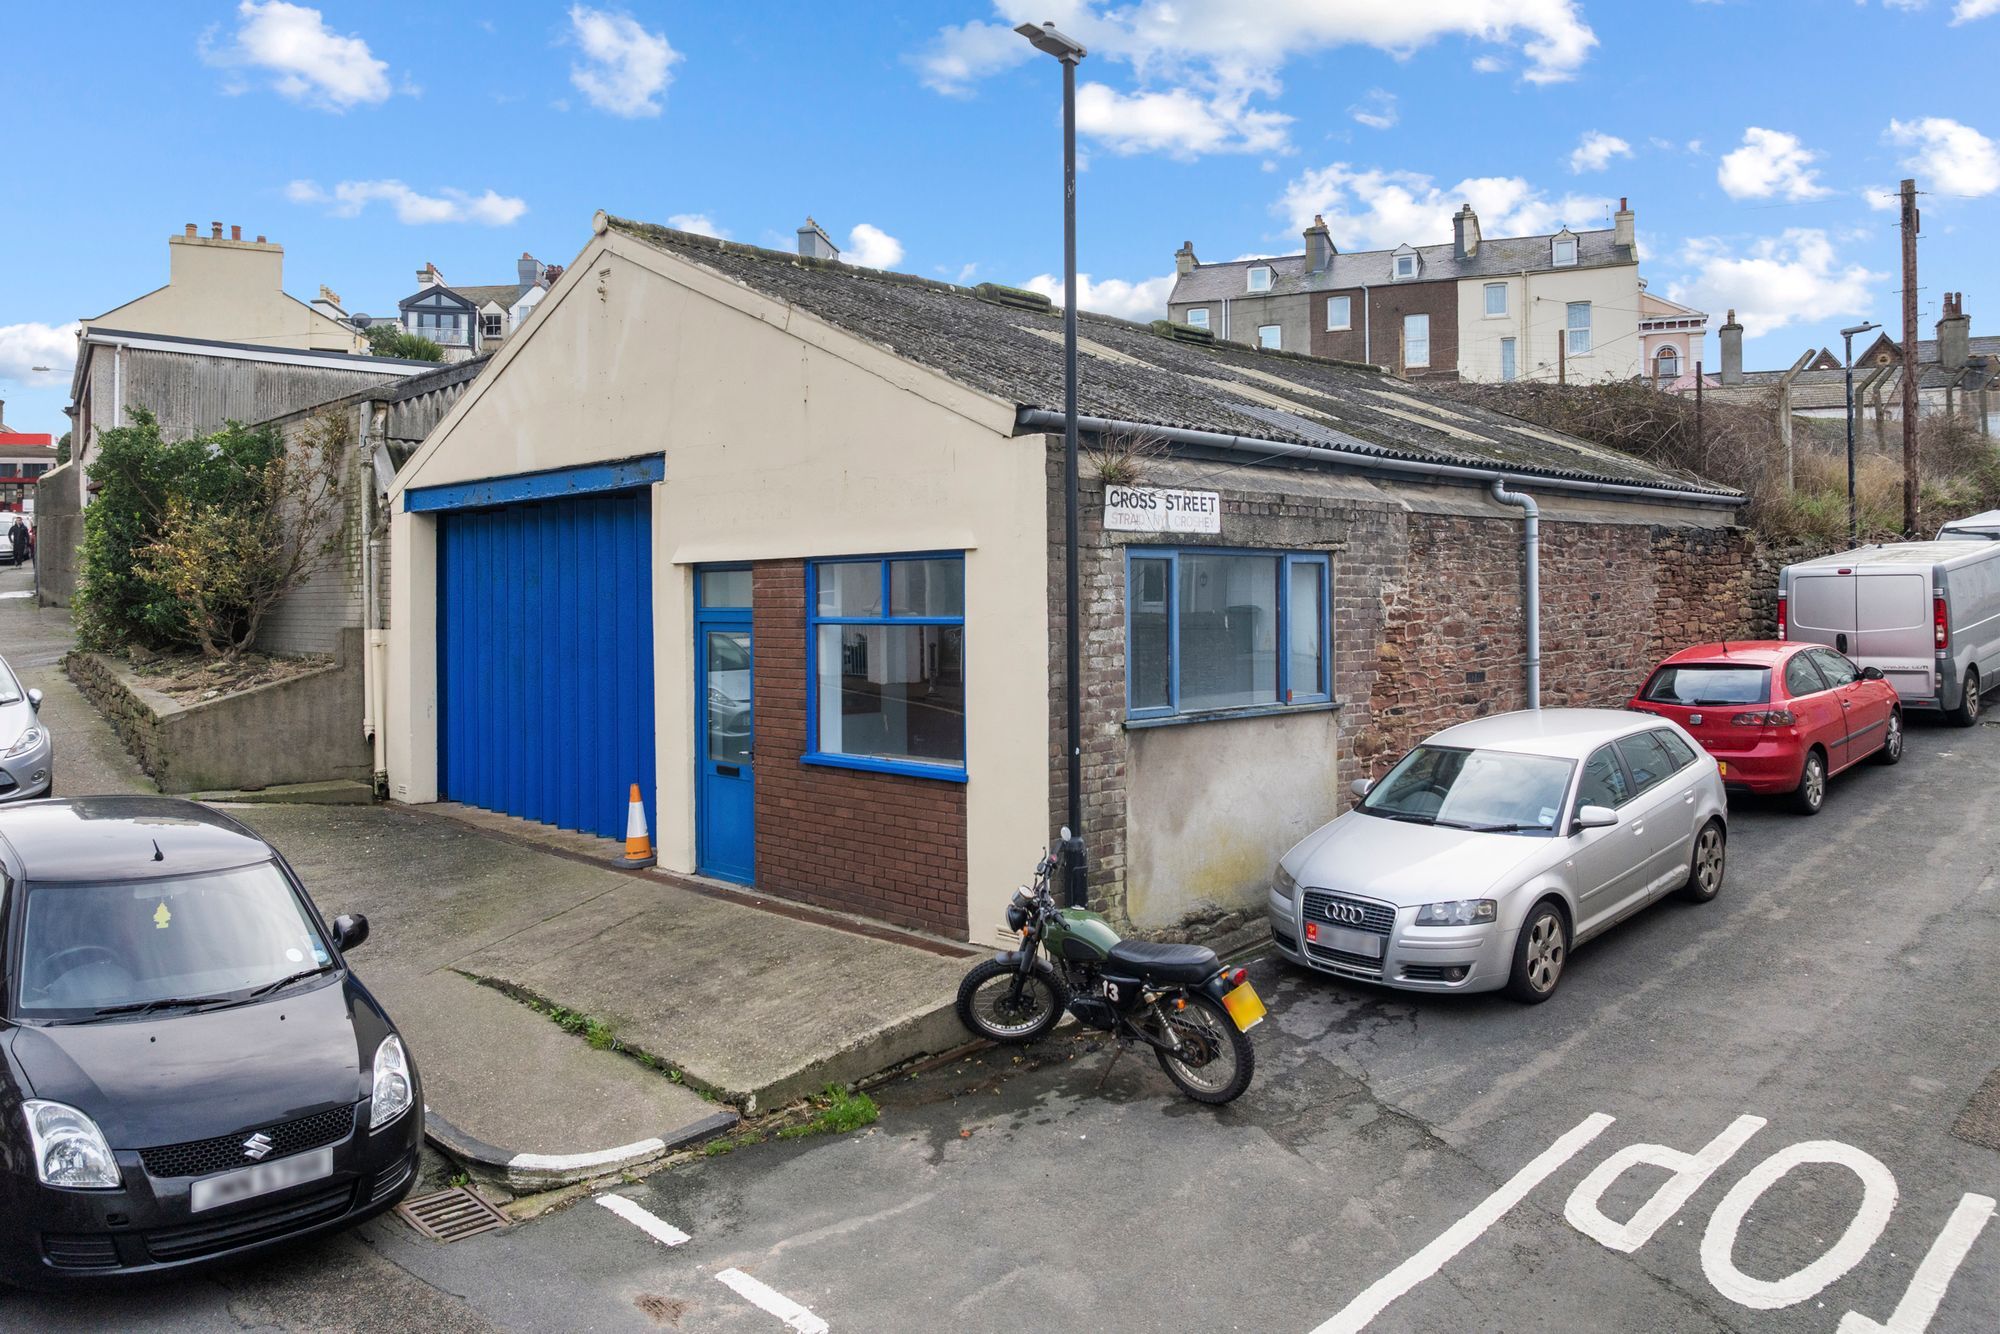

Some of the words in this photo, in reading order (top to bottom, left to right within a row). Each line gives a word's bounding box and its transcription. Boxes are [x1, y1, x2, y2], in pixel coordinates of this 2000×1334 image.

[1110, 490, 1157, 510] CROSS
[1165, 494, 1216, 513] STREET
[1102, 980, 1119, 1001] 13
